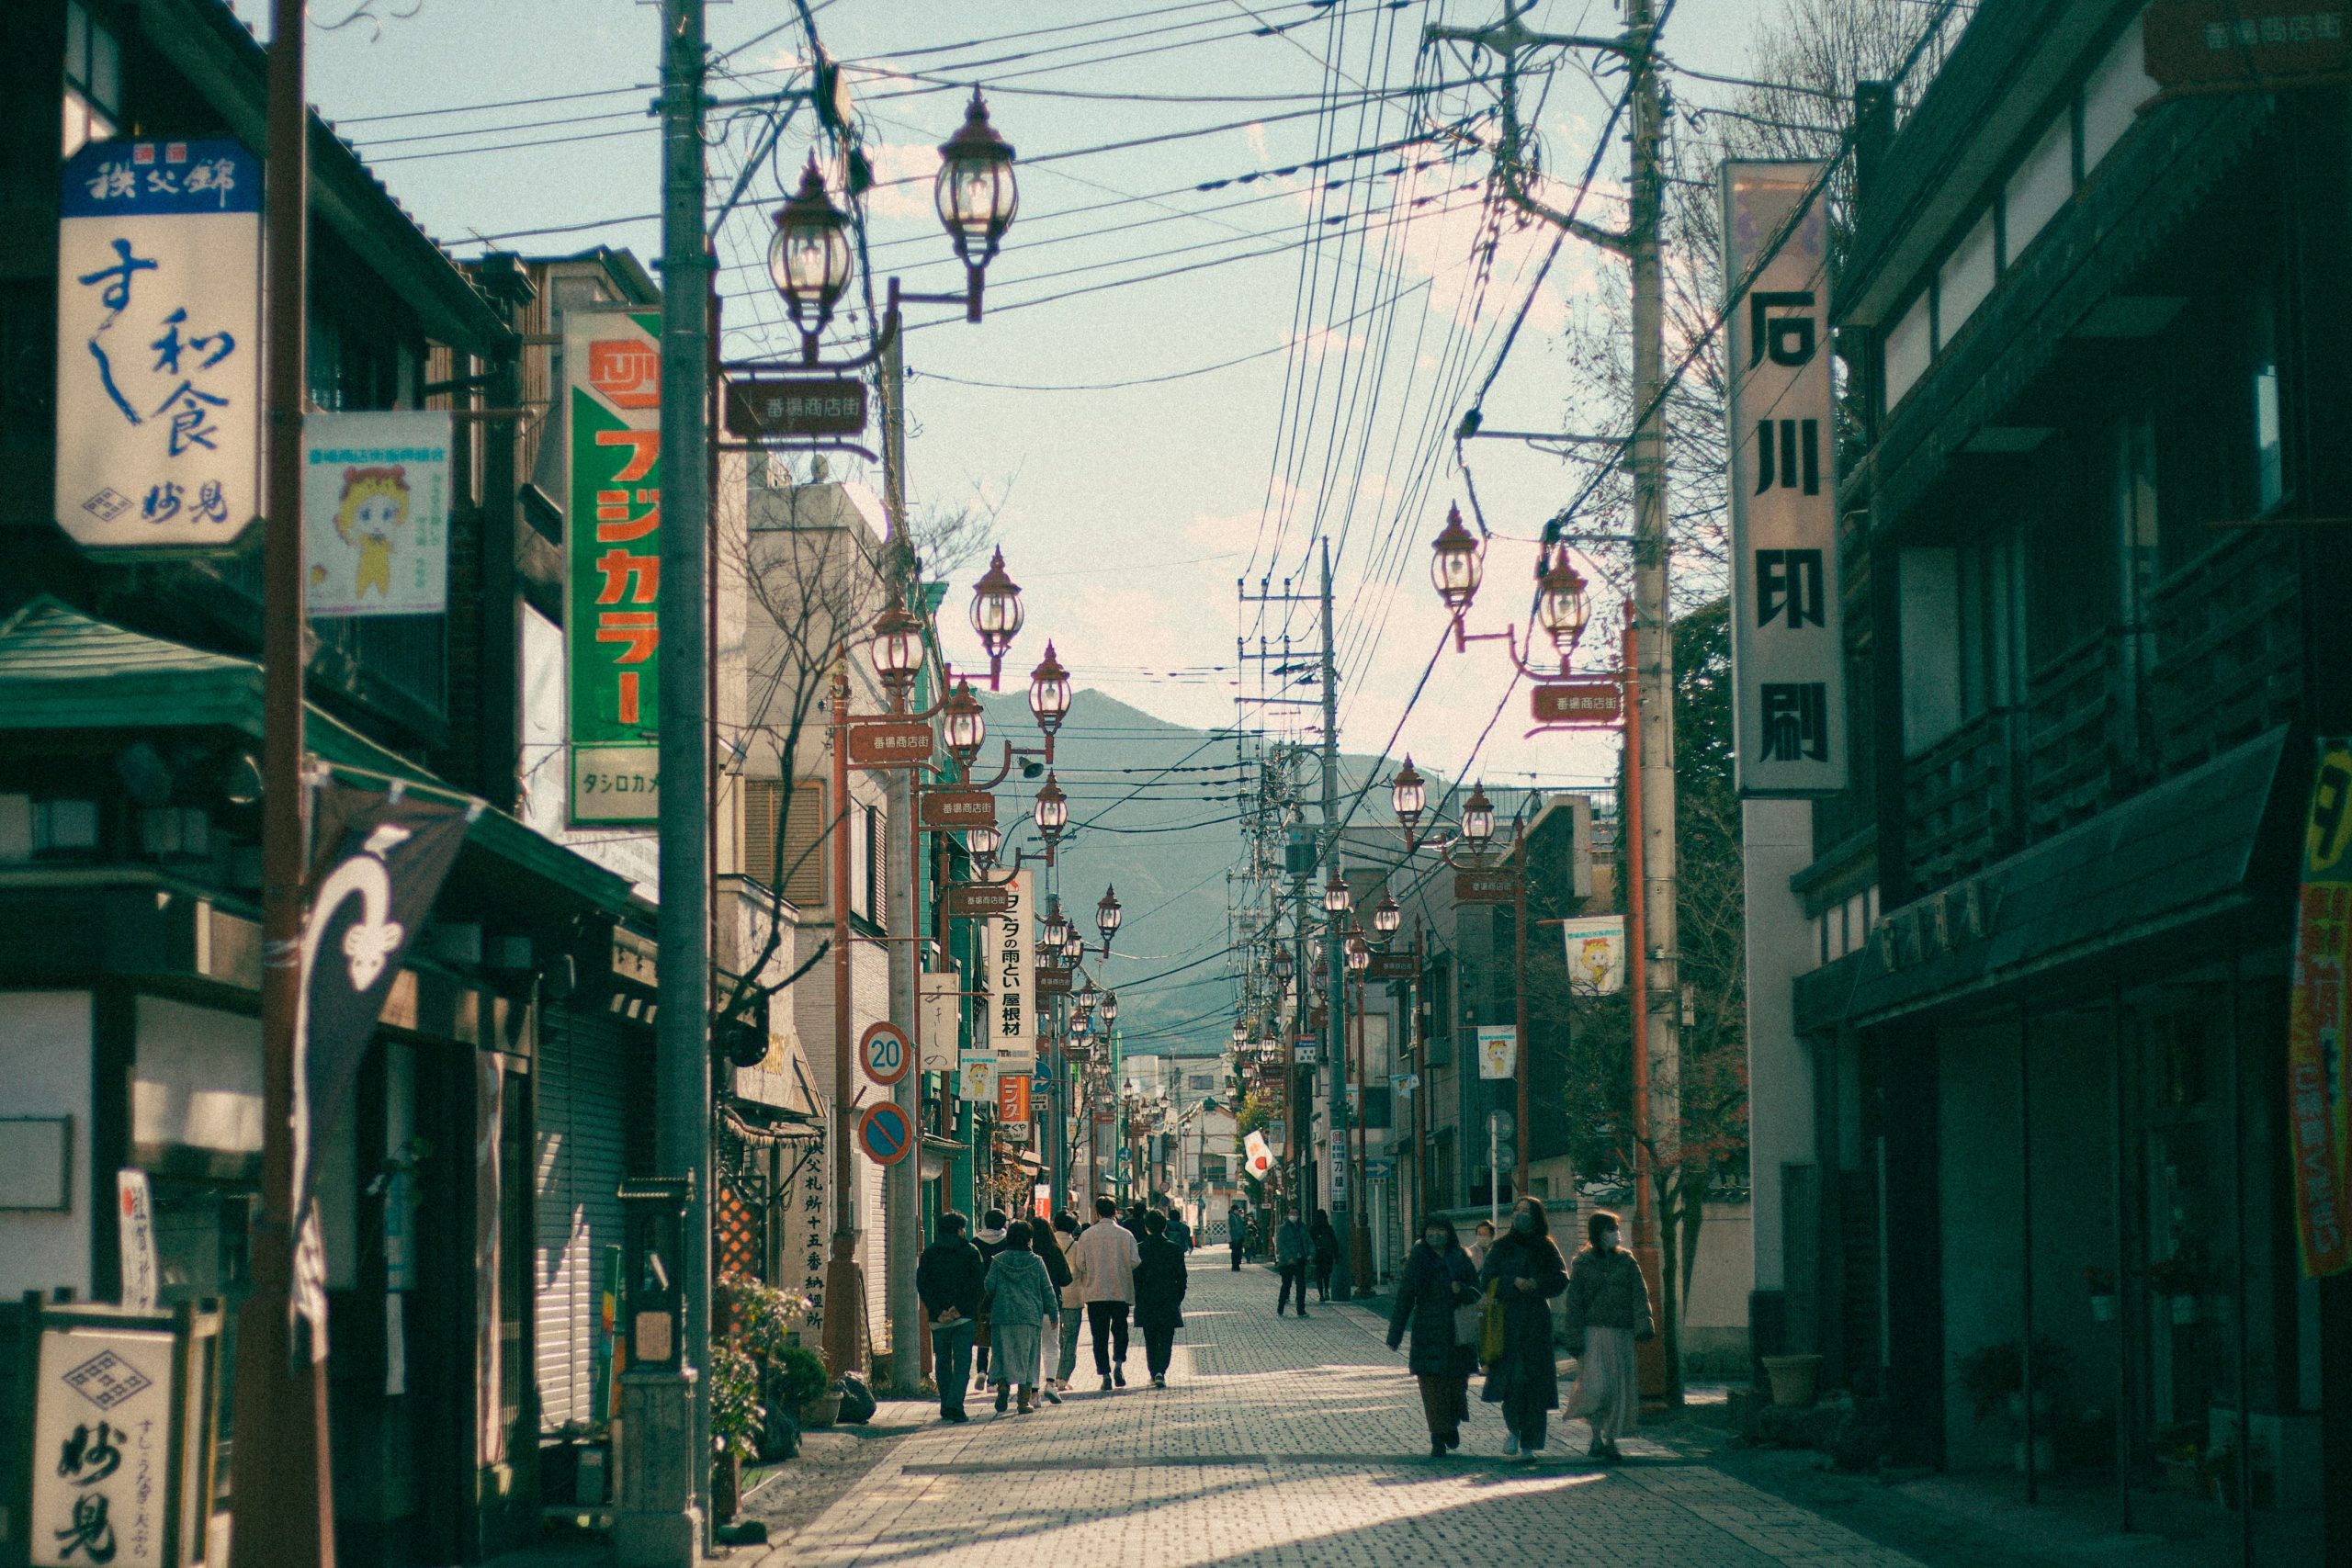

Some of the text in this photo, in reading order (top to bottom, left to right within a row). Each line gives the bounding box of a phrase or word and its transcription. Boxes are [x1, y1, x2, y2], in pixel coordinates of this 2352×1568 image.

[79, 239, 158, 425] すし
[151, 309, 235, 457] 和食
[766, 398, 860, 418] 番場商店街
[1750, 291, 1828, 764] 石川印刷
[596, 430, 660, 724] フジカラー
[1556, 697, 1617, 710] 番場商店街
[874, 735, 930, 750] 番場商店街
[943, 802, 992, 815] 番場商店街
[1001, 993, 1022, 1036] 屋根材
[871, 1040, 900, 1068] 20
[1285, 1162, 1299, 1202] そば
